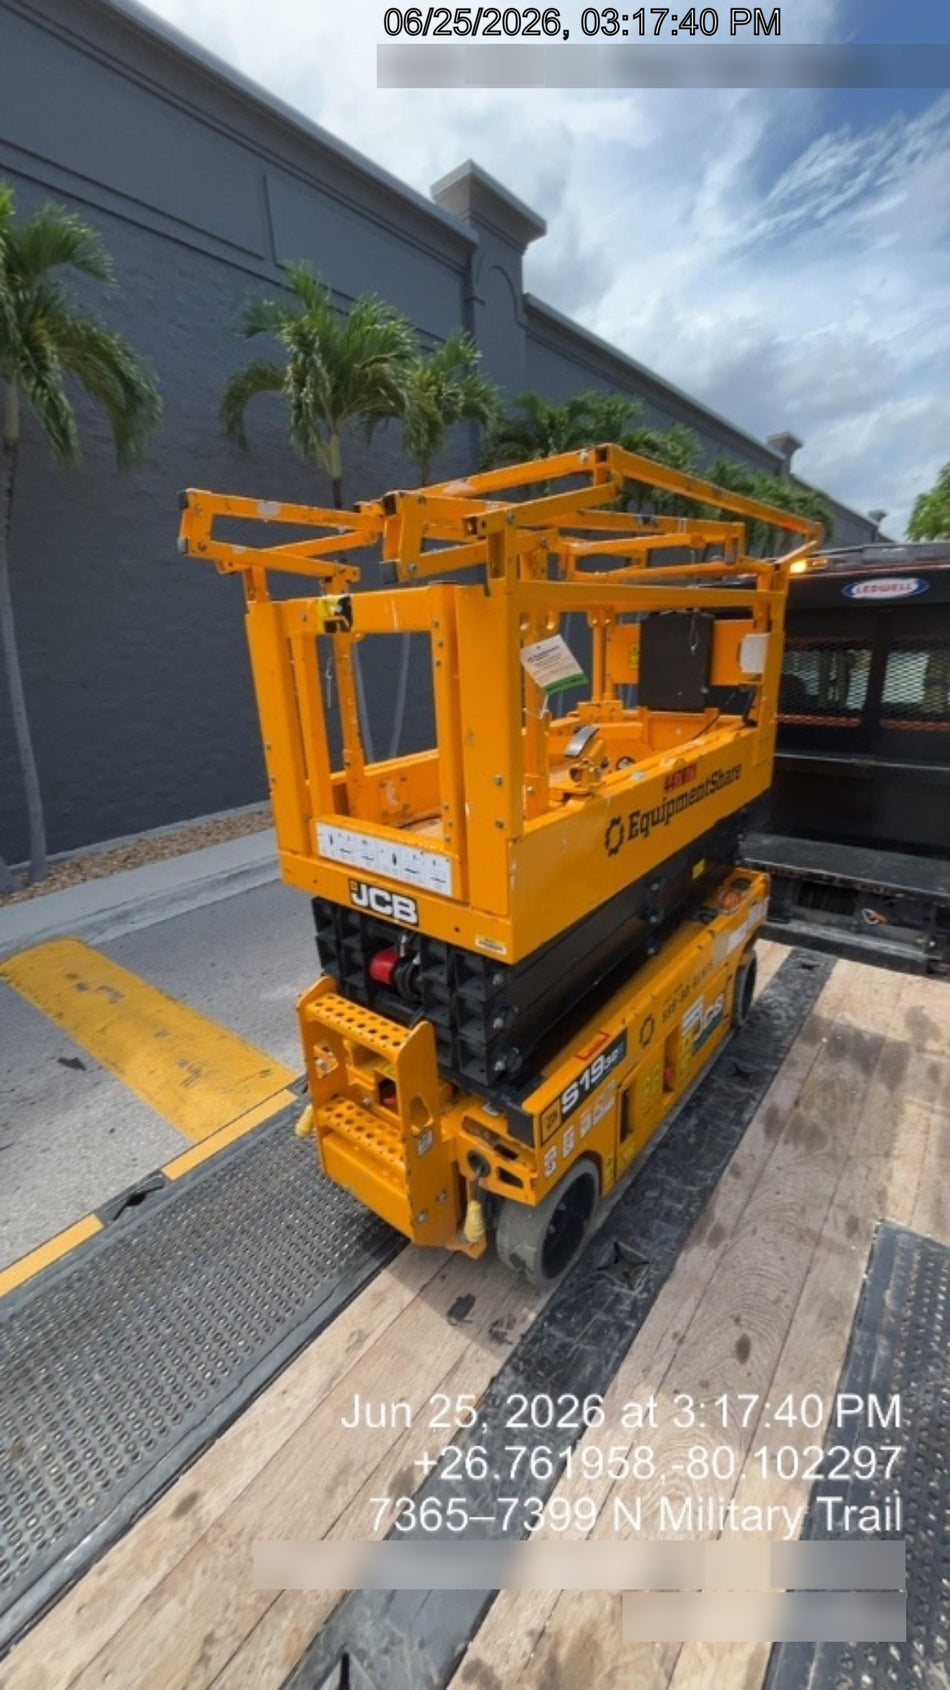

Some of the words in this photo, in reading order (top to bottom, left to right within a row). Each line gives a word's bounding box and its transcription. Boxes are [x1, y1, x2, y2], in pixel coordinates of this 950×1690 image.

[855, 582, 913, 595] LEDWELL
[627, 763, 742, 840] EquipmentShare
[351, 882, 418, 925] JCB
